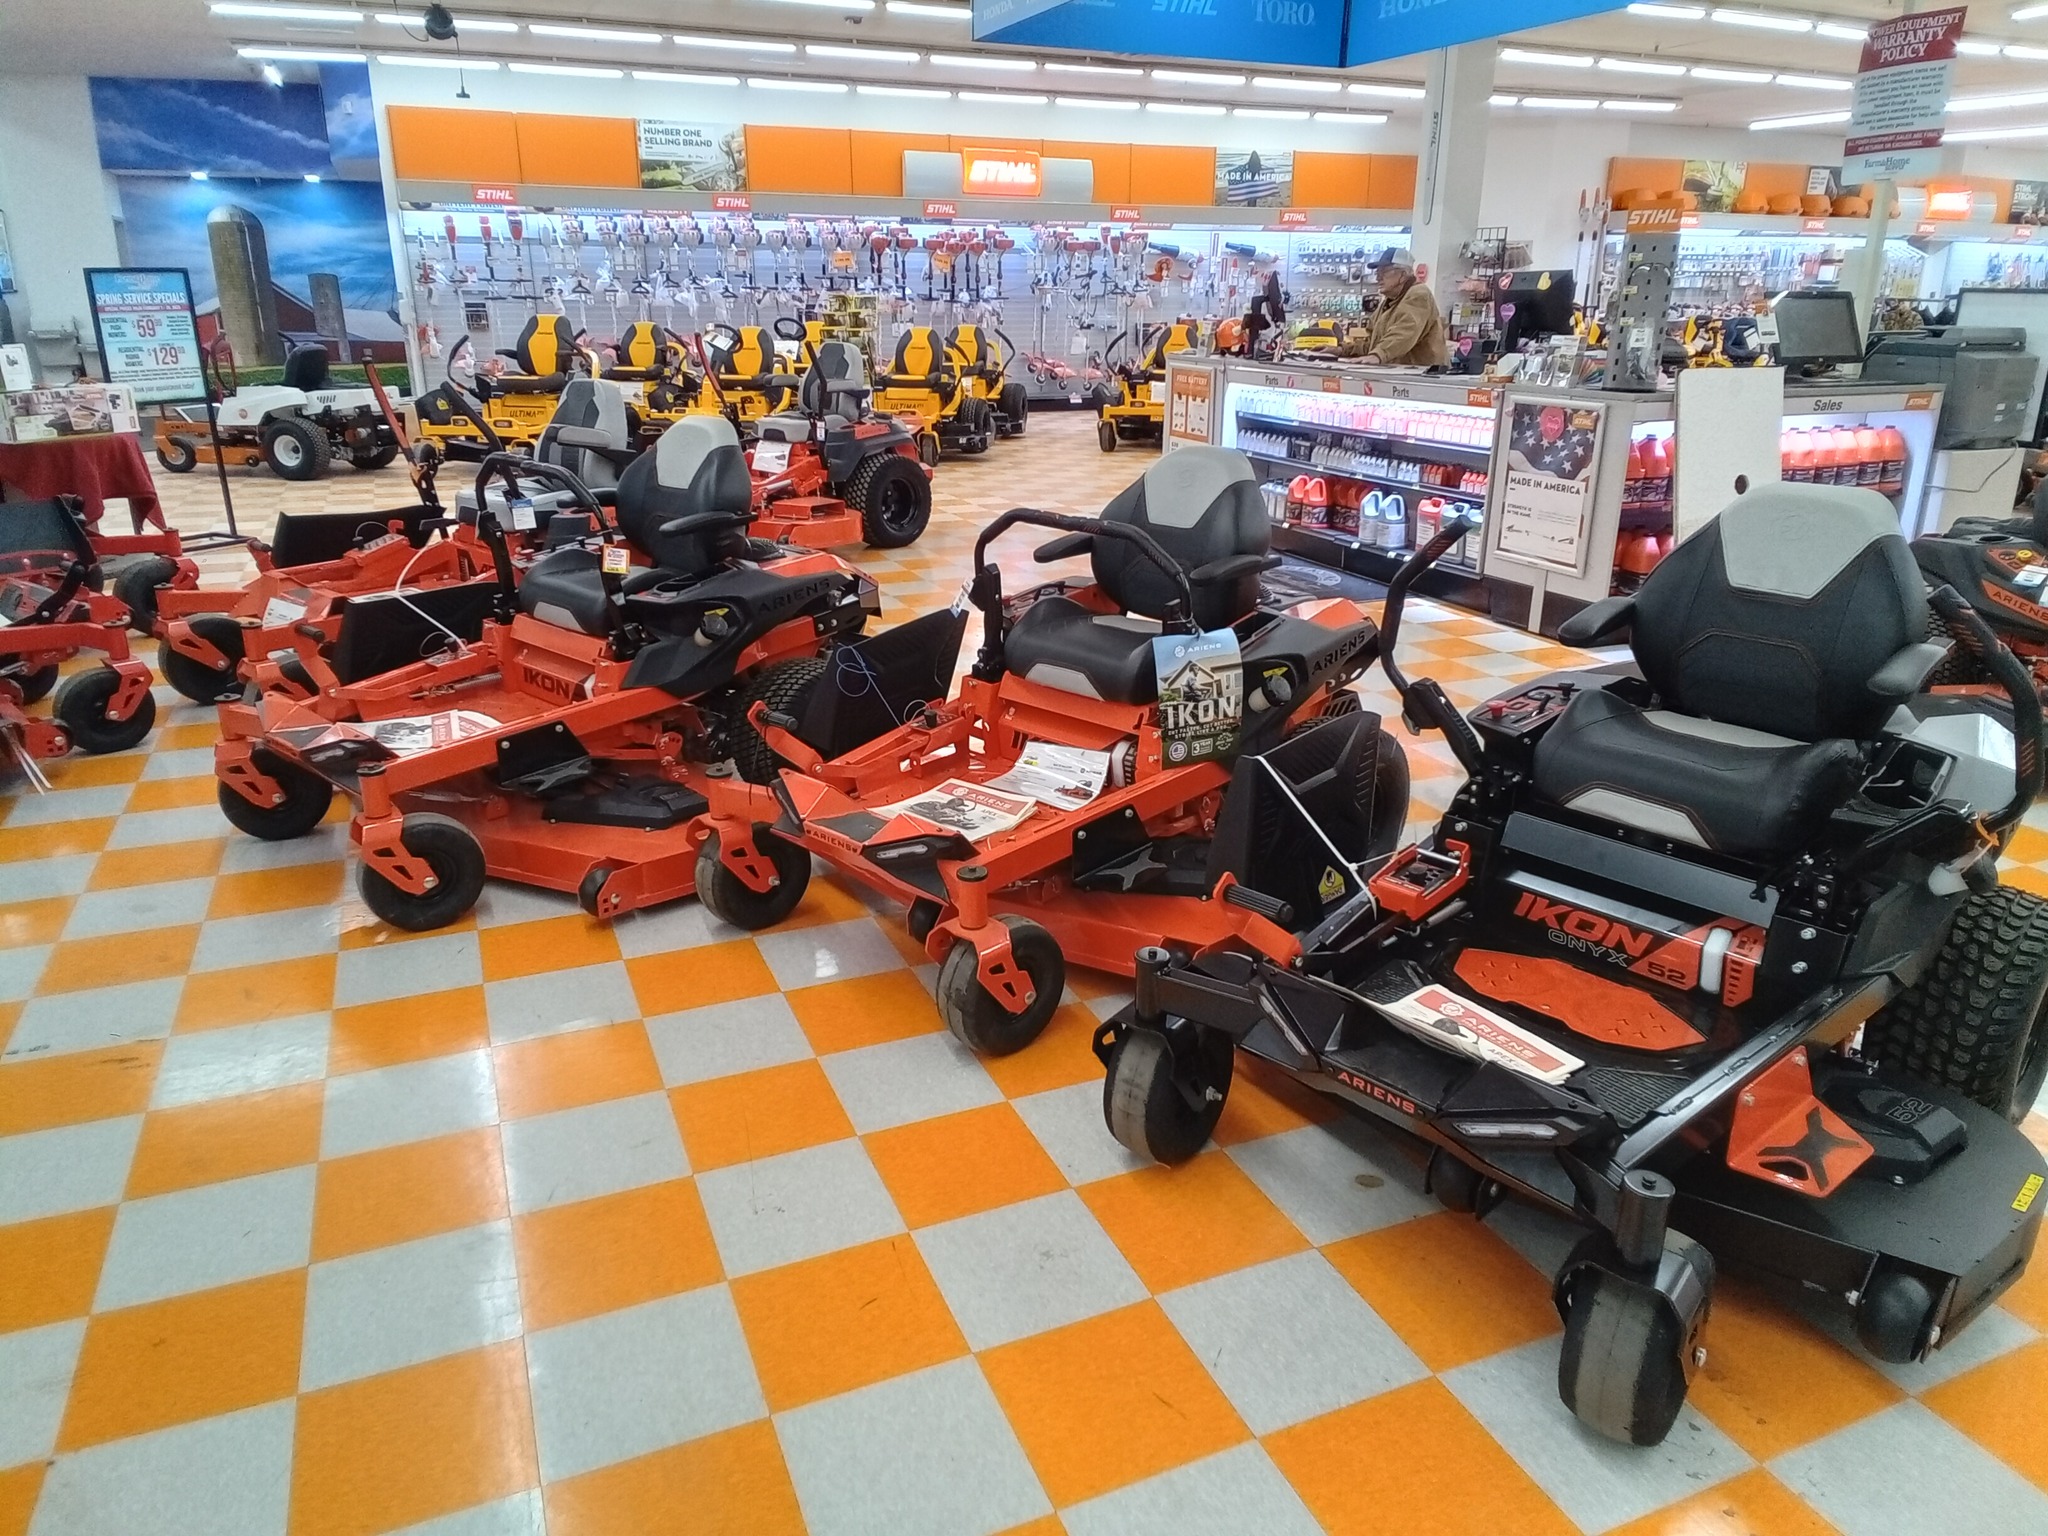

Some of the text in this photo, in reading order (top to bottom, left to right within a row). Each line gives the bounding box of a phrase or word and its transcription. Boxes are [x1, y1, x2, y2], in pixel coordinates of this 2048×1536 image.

[983, 0, 1014, 21] HONDA
[1254, 0, 1314, 26] TORO
[1896, 12, 1962, 31] EQUIPMENT
[1873, 26, 1947, 51] WARRANTY
[1879, 43, 1929, 64] POLICY
[643, 127, 702, 138] NUMBER ONE
[1430, 111, 1440, 148] STIHL
[644, 136, 713, 148] SELLING BRAND
[968, 159, 1037, 183] STIHL
[1217, 171, 1293, 182] MADE IN AMERICA
[475, 189, 514, 201] STIHL
[716, 197, 750, 208] STIHL
[926, 204, 956, 214] STIHL
[1113, 209, 1140, 219] STIHL
[1628, 209, 1680, 225] STIHL
[1282, 212, 1307, 223] STIHL
[1806, 221, 1825, 229] STIHL
[95, 292, 186, 306] SPRING SERVICE SPECIALS
[1265, 374, 1279, 386] Parts
[1392, 385, 1410, 398] Parts
[1469, 393, 1489, 403] STIHL
[890, 402, 917, 410] ULTIMA
[1813, 399, 1843, 412] Sales
[510, 410, 537, 418] ULTIMA
[1574, 417, 1593, 426] STIHL
[1510, 476, 1581, 496] MADE IN AMERICA
[759, 578, 830, 612] ARIENS
[1993, 591, 2048, 621] ARIENS
[1187, 642, 1222, 653] ARIENS
[1311, 630, 1366, 675] ARIENS
[523, 665, 570, 700] IKON
[1166, 695, 1236, 729] IKON
[1193, 743, 1200, 754] 3
[967, 793, 1012, 809] ARIENS
[813, 830, 851, 851] ARIENS
[1513, 892, 1654, 958] IKON
[1548, 929, 1628, 968] ONYX
[1647, 961, 1687, 986] 52
[1460, 1017, 1537, 1059] ARIENS
[1488, 1048, 1516, 1065] APEX
[1338, 1071, 1415, 1115] ARIENS
[1885, 1097, 1934, 1124] 52
